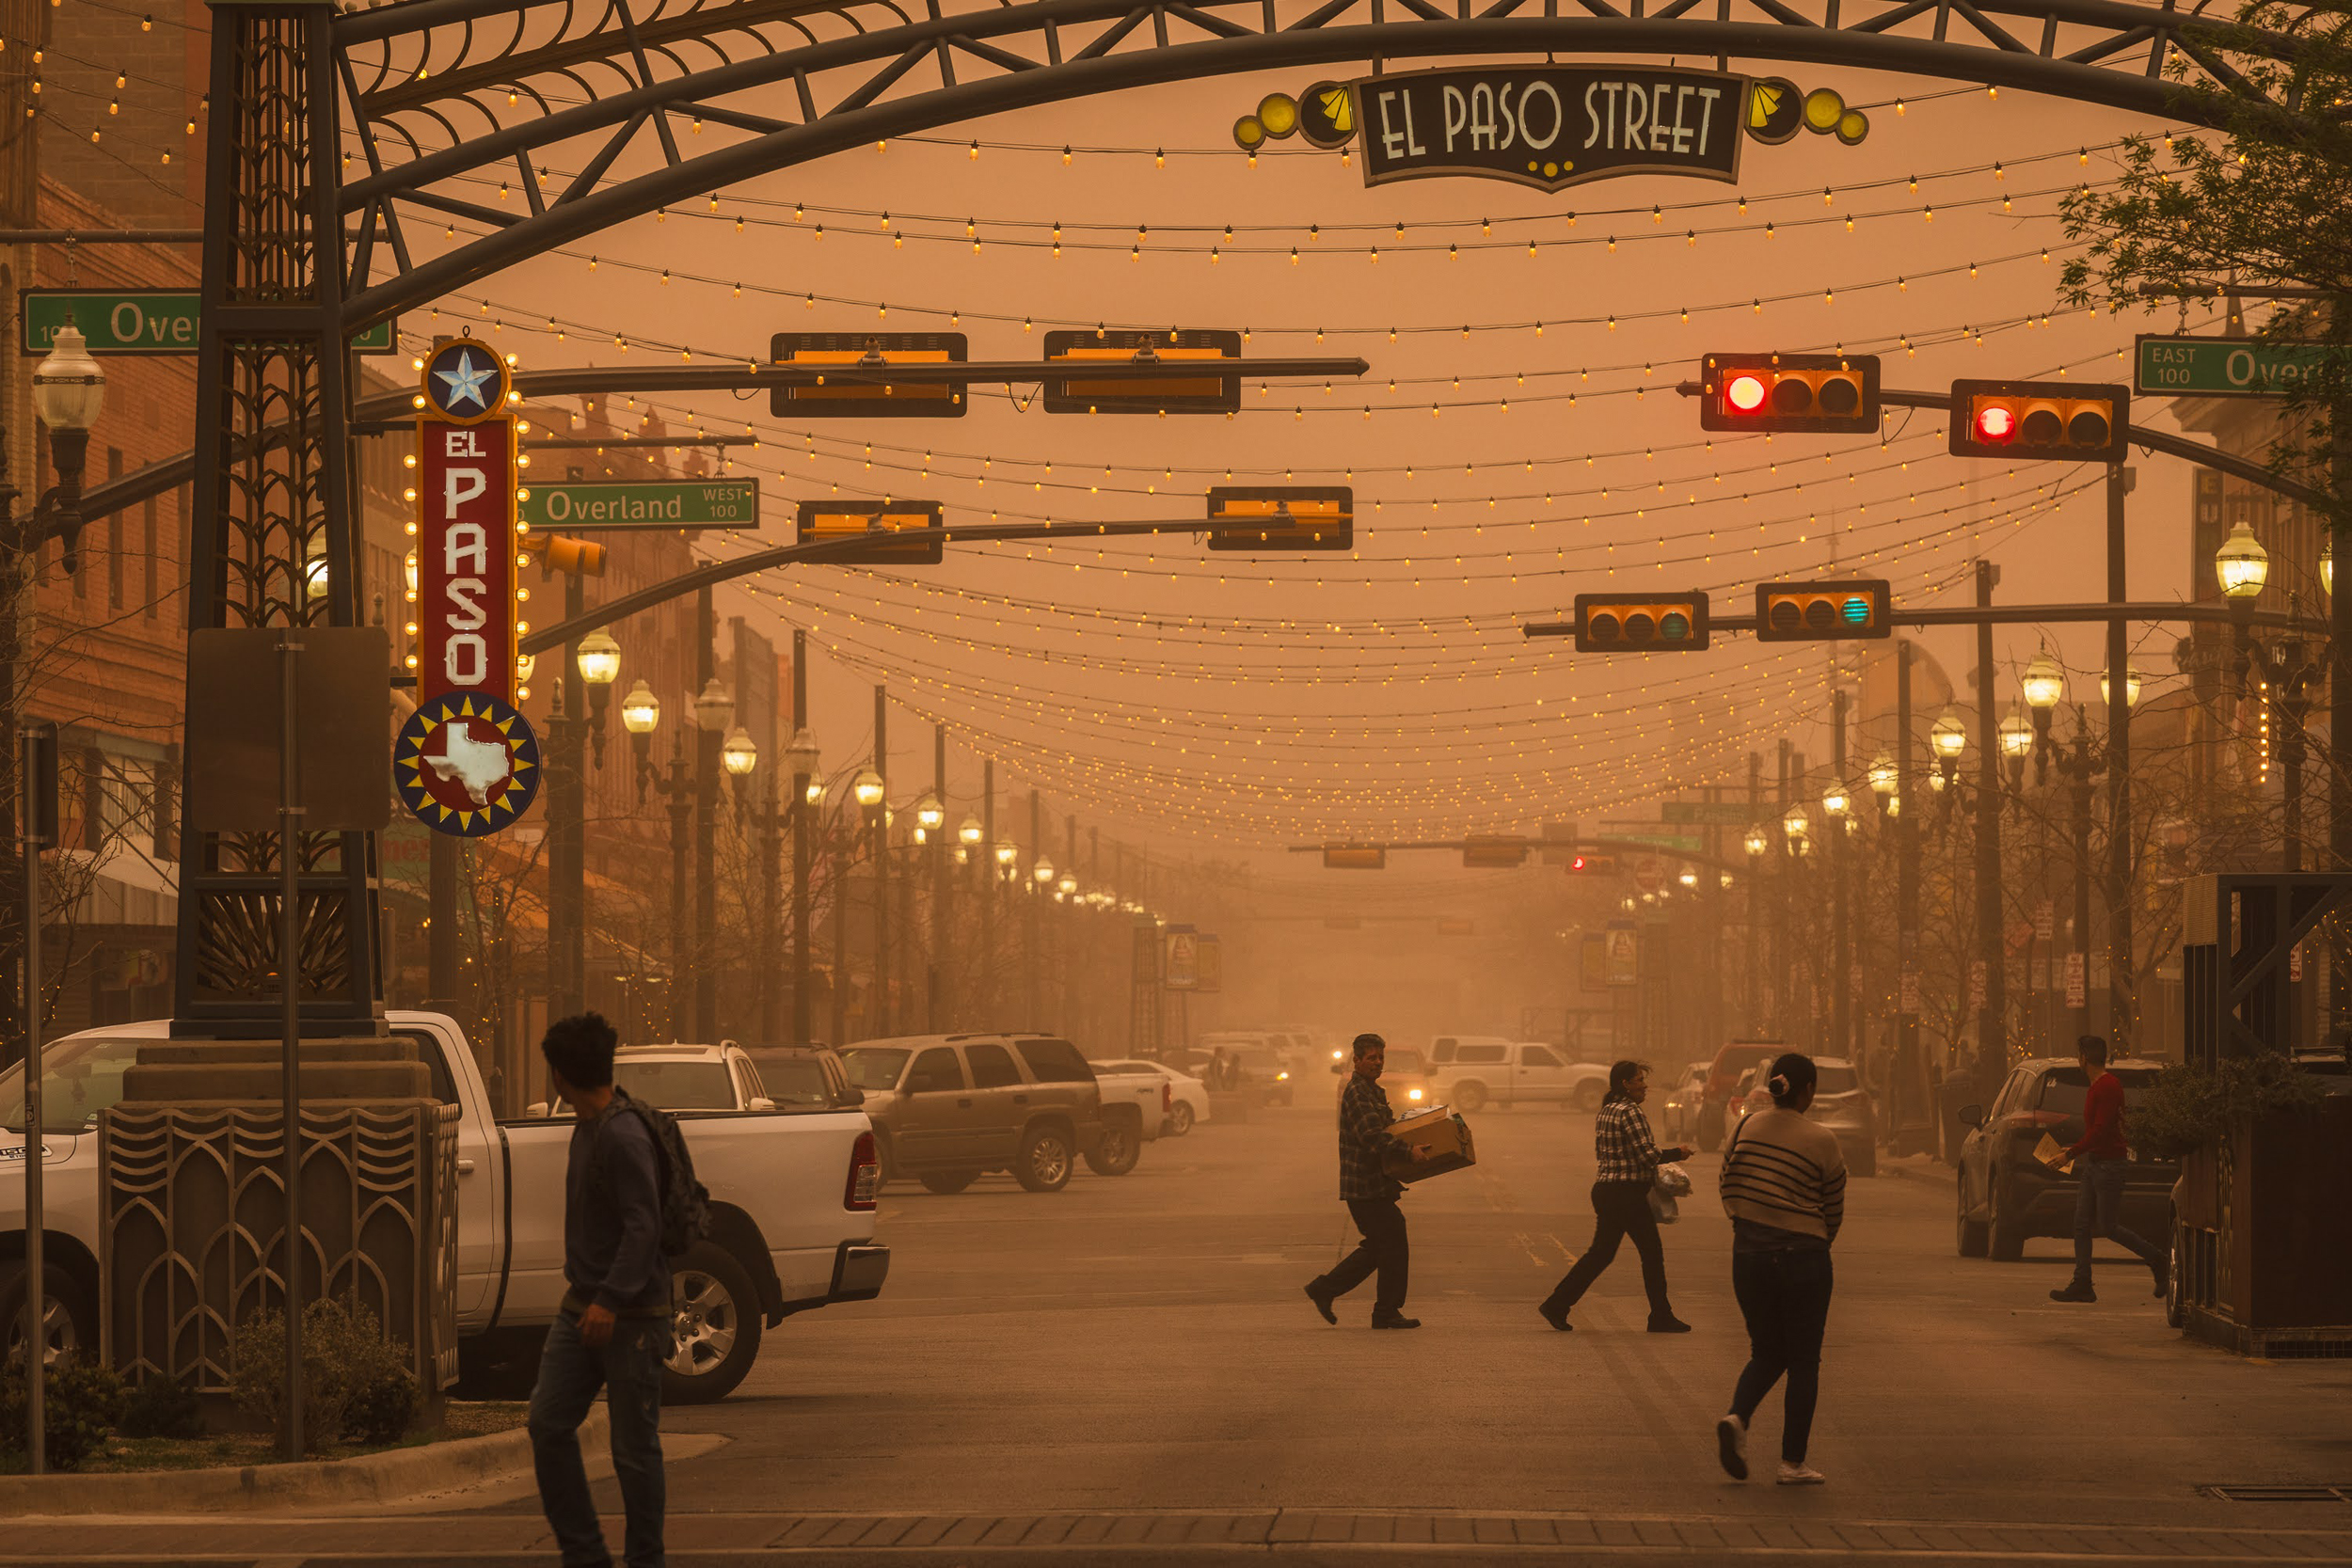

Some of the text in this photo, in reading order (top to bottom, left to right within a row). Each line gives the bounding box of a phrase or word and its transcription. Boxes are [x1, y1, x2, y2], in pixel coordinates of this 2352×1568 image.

[1378, 81, 1722, 160] EL PASO STREET
[2153, 347, 2196, 364] EAST
[2157, 368, 2191, 385] 100
[445, 431, 486, 457] EL
[703, 488, 743, 501] WEST
[547, 491, 681, 521] Overland
[709, 505, 738, 517] 100
[443, 467, 488, 686] PASO
